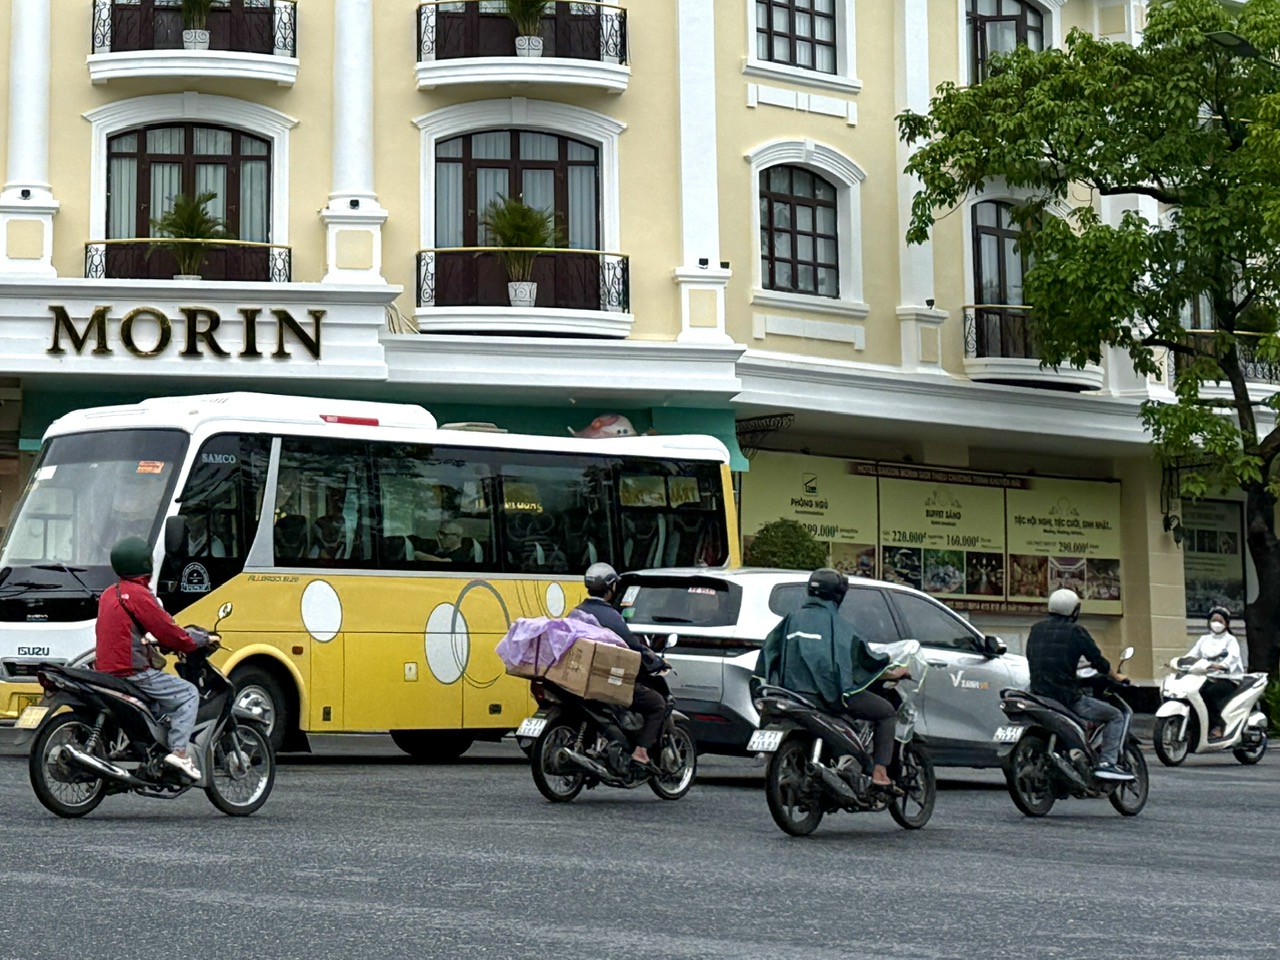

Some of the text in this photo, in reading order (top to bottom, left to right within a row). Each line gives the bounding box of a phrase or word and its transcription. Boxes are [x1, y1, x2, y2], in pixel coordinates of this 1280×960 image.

[47, 304, 327, 360] MORIN
[201, 453, 236, 464] SAMCO
[18, 646, 50, 656] ISUZU
